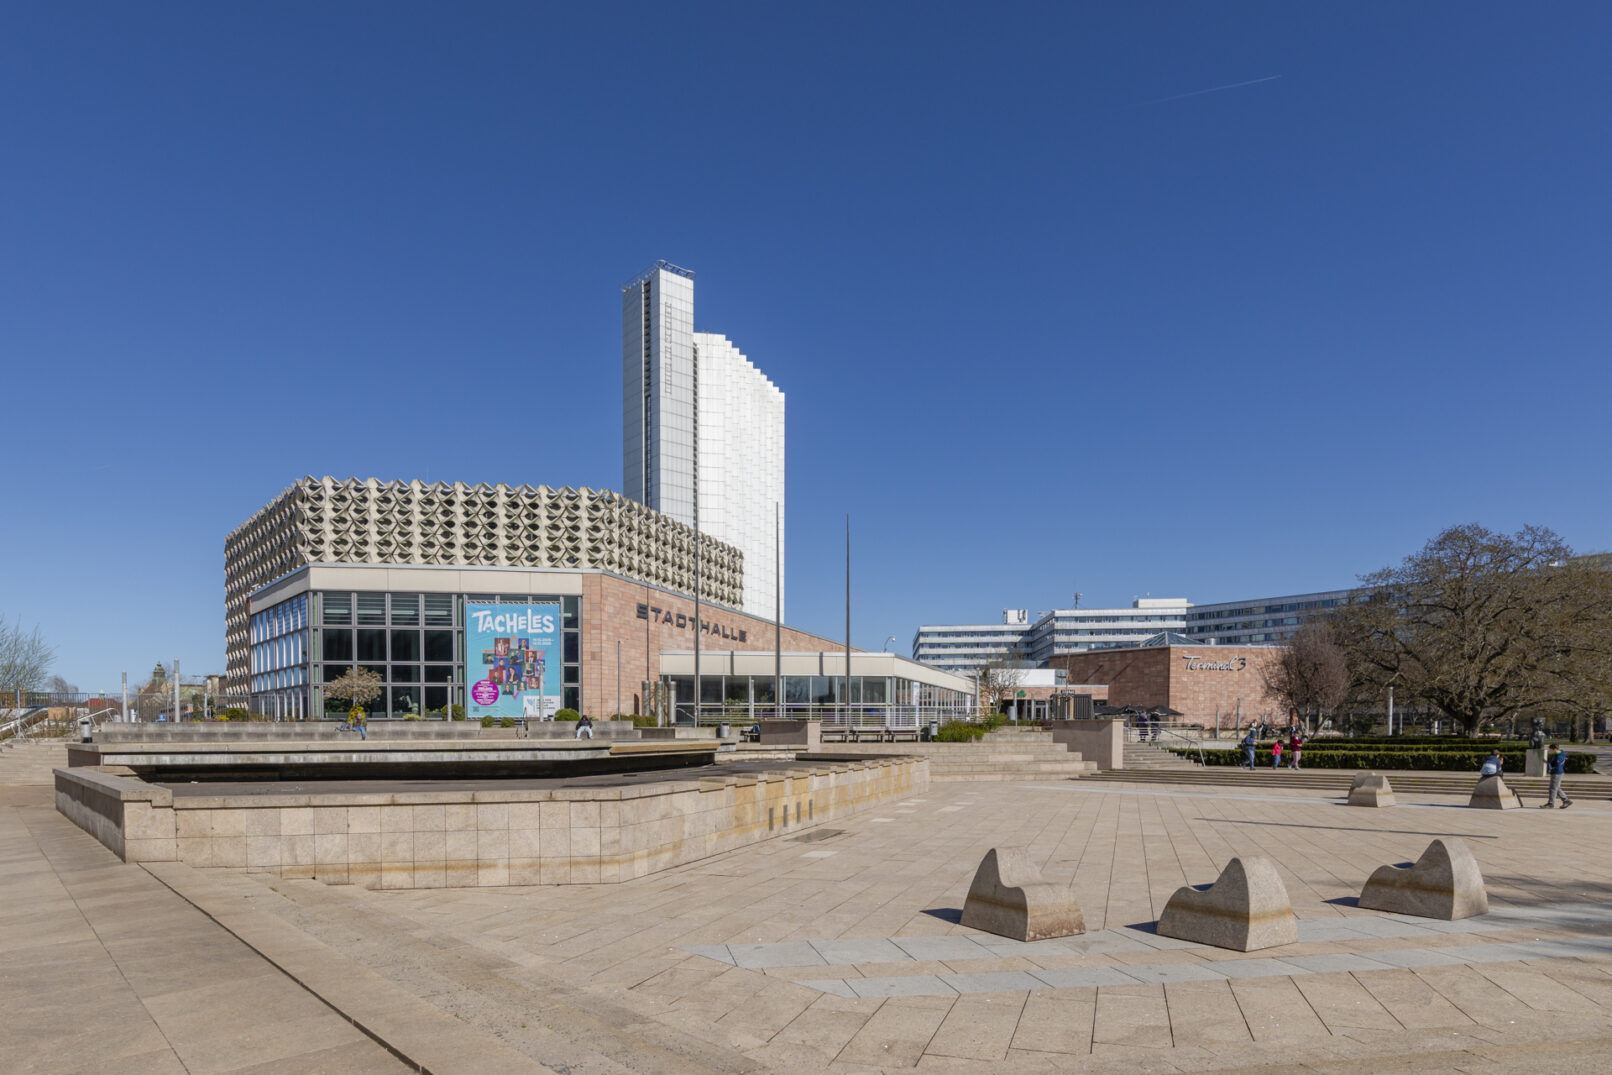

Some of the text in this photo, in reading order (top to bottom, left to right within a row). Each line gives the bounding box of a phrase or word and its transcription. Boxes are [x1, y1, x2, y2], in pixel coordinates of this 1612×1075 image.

[472, 608, 555, 634] TACHELES
[636, 602, 747, 643] STADTHALLE
[1182, 655, 1247, 671] Terminal 3
